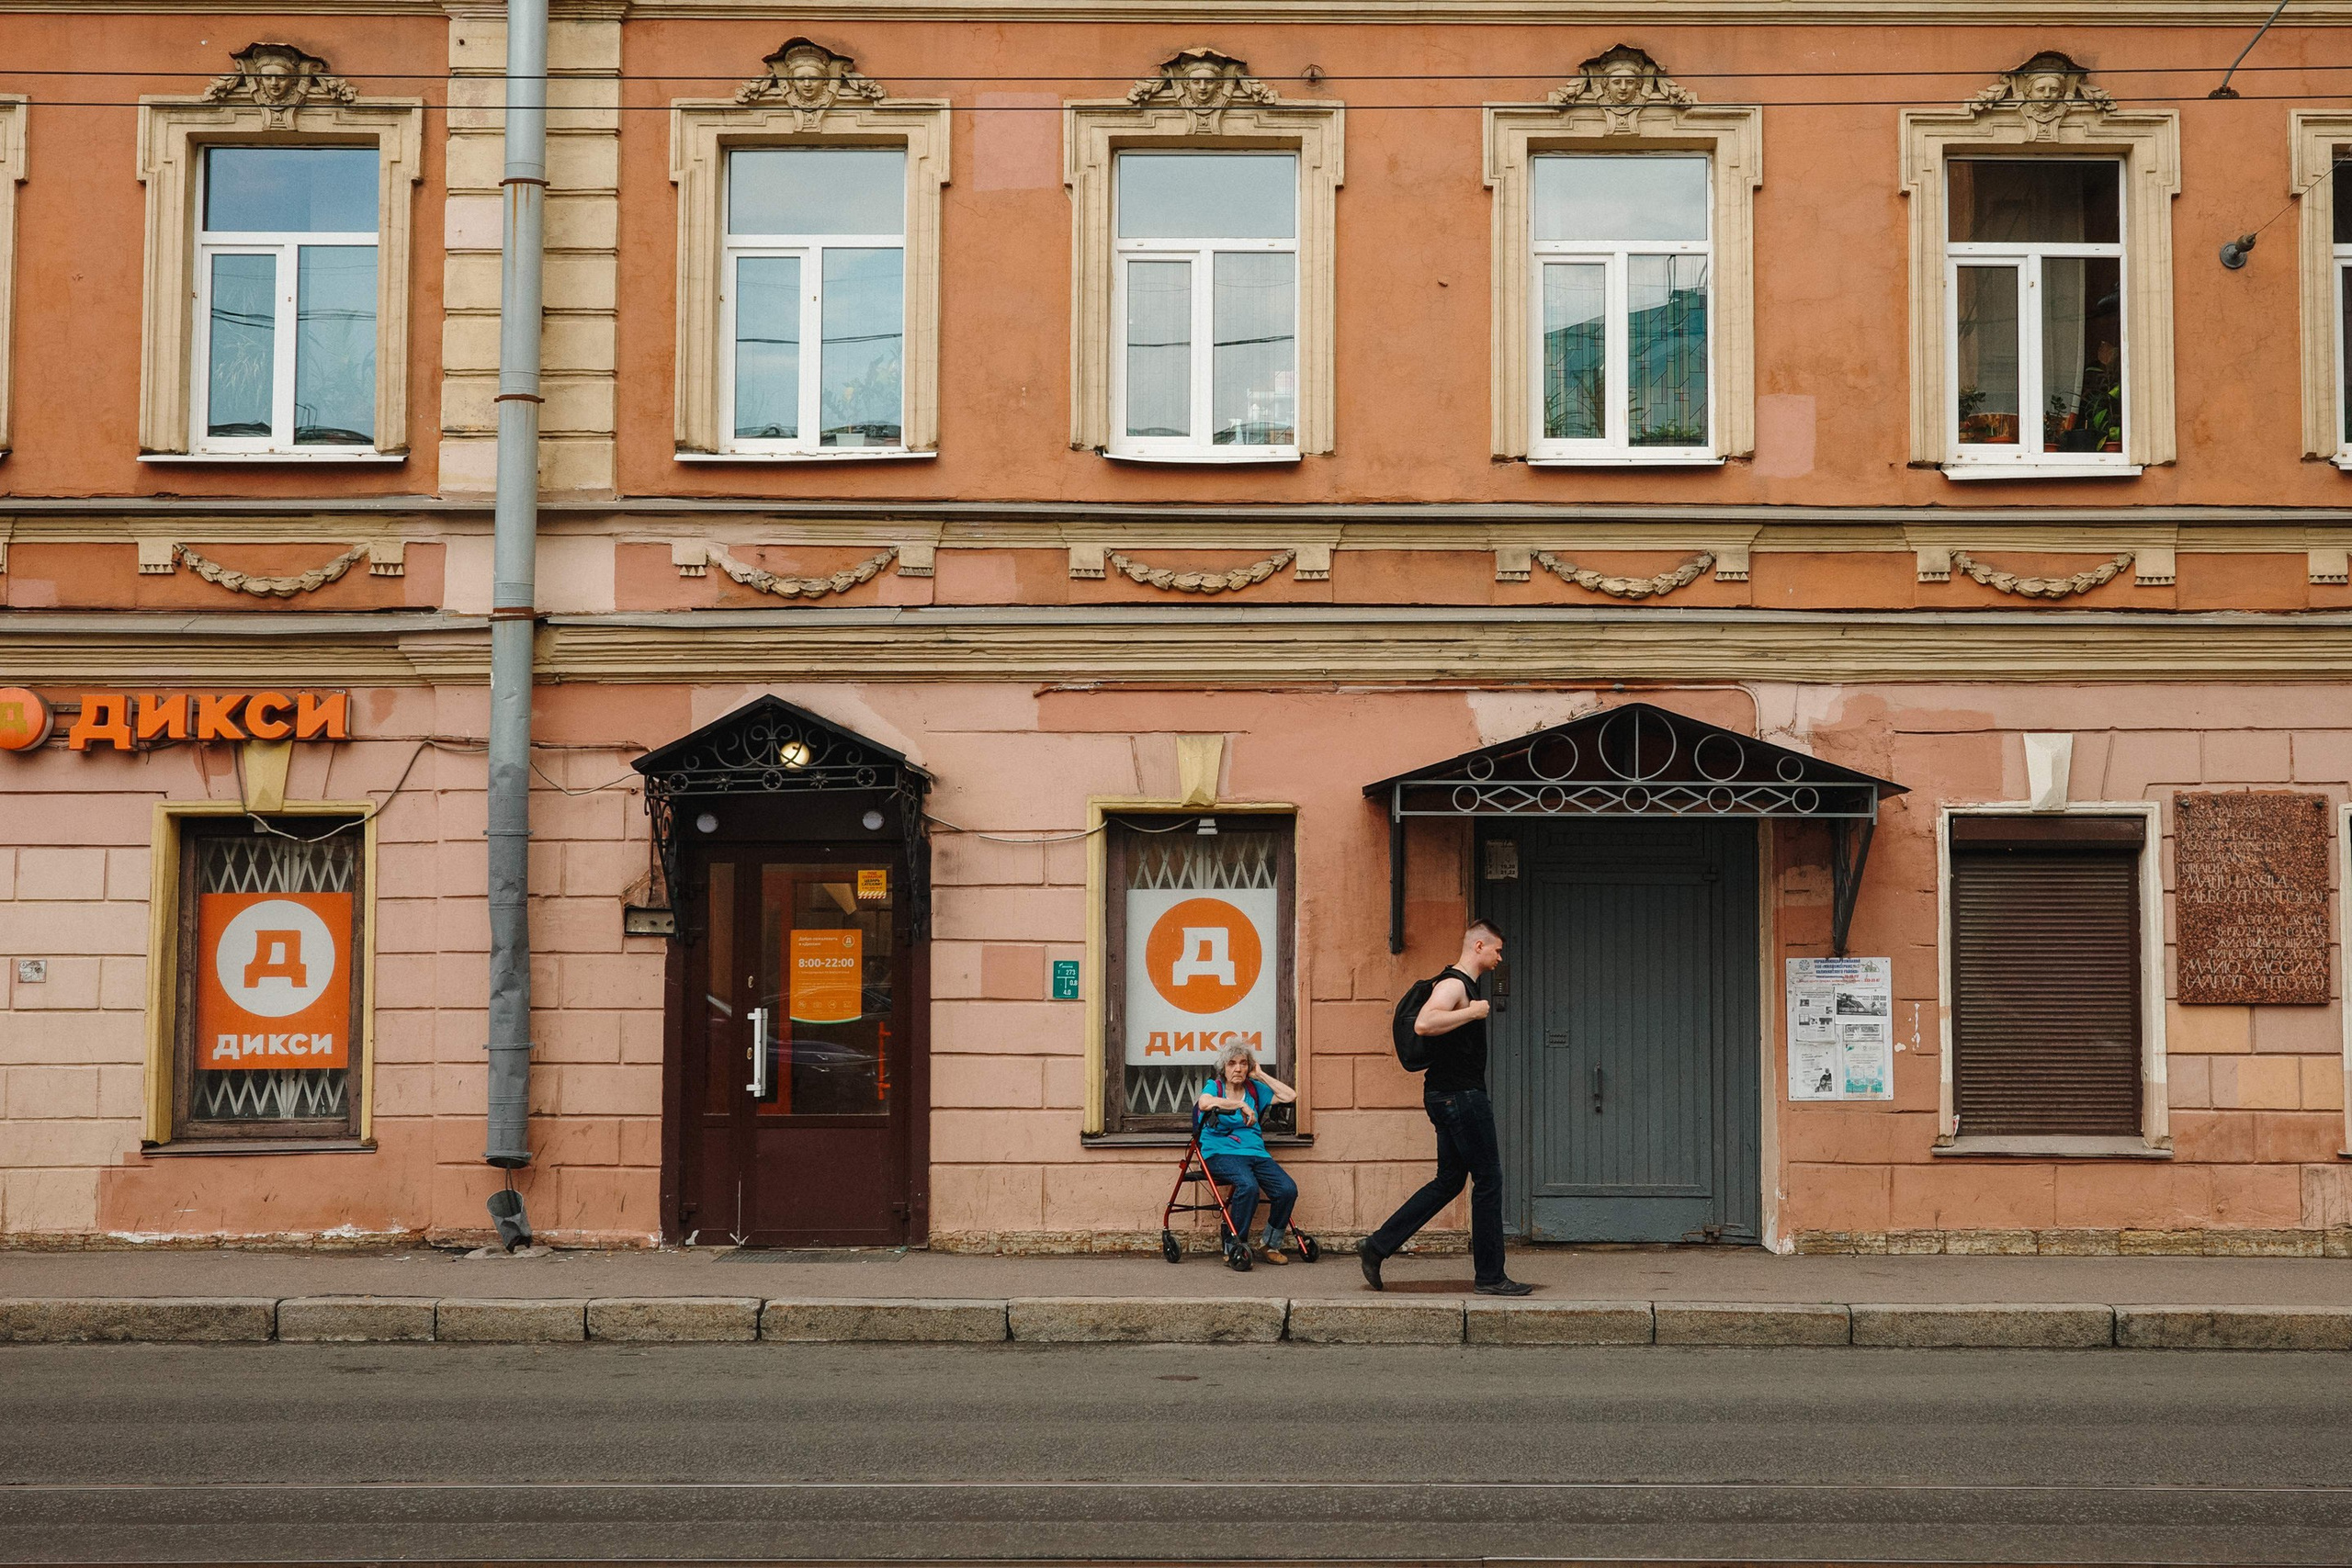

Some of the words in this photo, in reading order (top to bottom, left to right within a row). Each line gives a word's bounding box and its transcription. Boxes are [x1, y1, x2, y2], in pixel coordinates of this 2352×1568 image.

[69, 691, 351, 751] ДИКСИ
[243, 930, 308, 988] Д
[798, 958, 854, 968] 8:00-22:00
[1172, 927, 1237, 987] Д
[2253, 974, 2324, 990] УНТОЛА)
[212, 1033, 333, 1061] ДИКСИ
